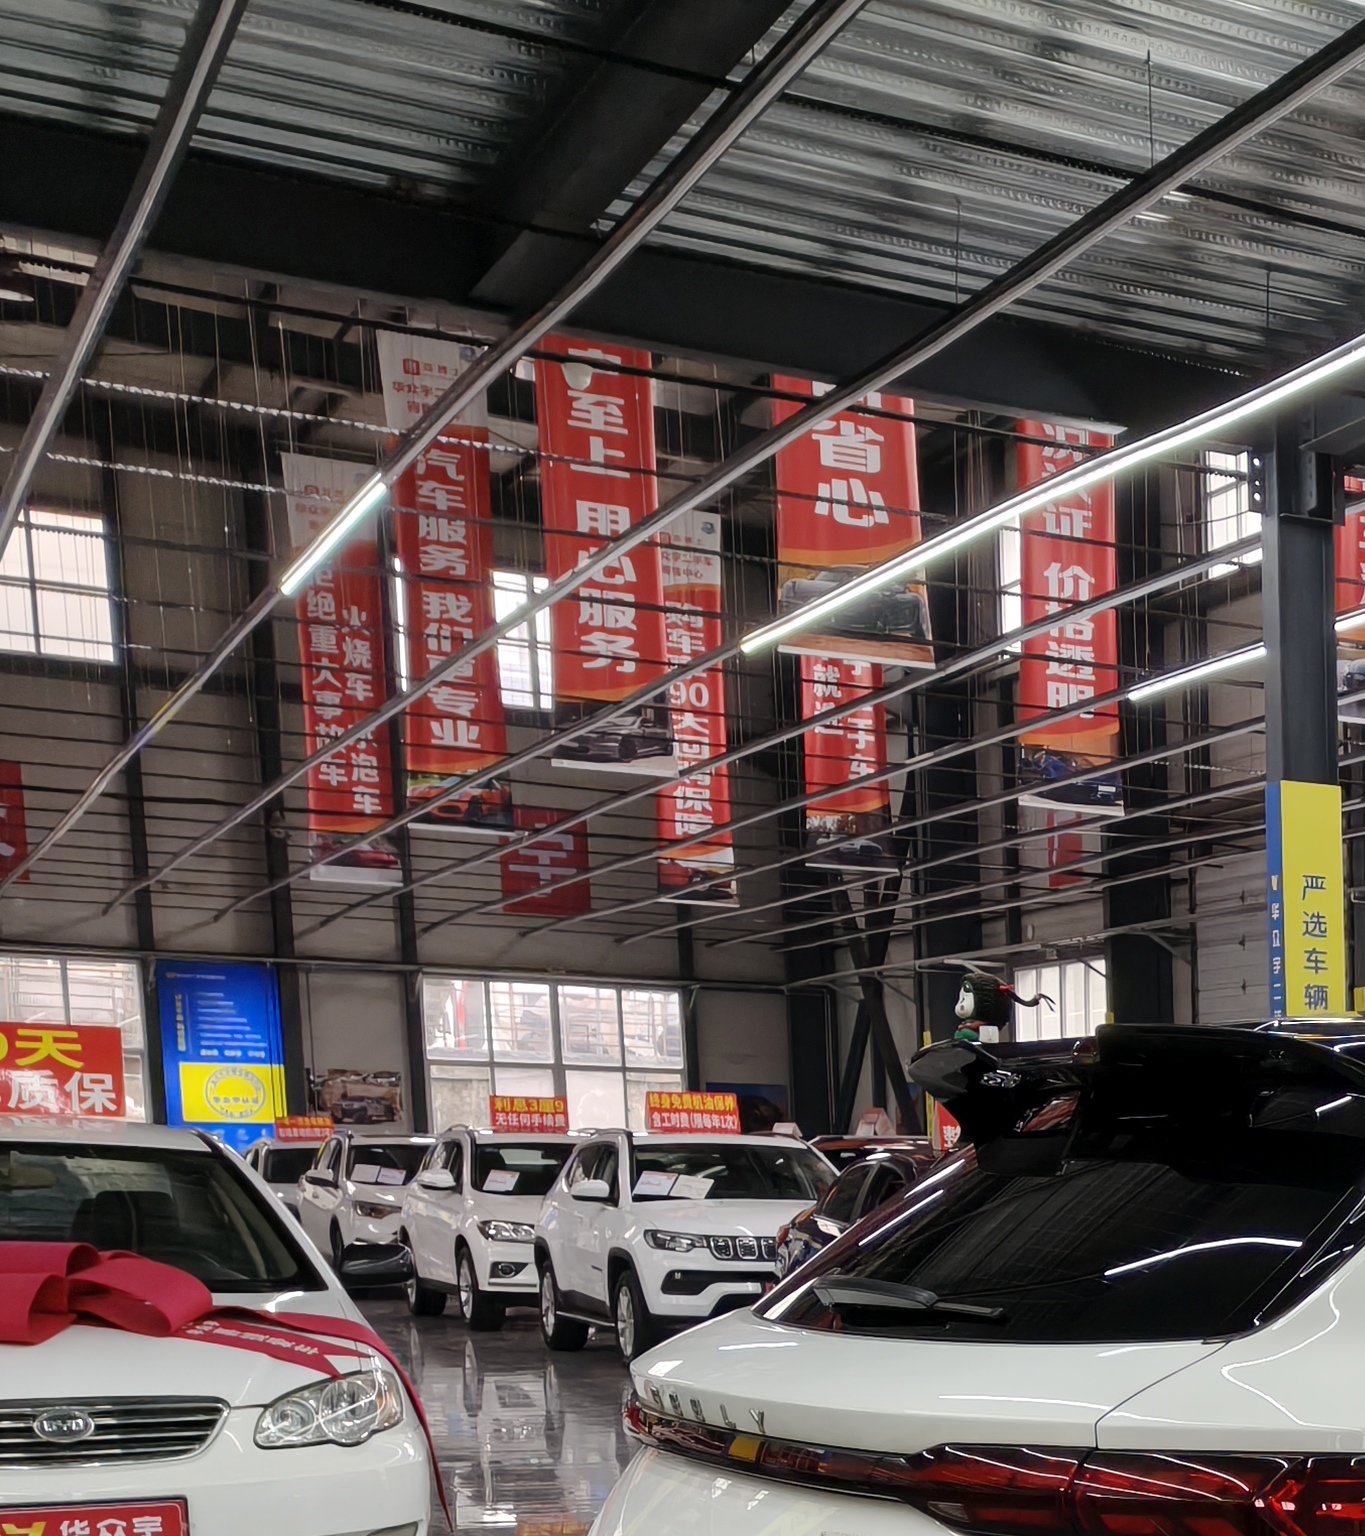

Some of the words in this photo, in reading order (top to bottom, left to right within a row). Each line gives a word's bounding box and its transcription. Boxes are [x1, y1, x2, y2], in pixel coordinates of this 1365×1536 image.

[417, 447, 469, 577] 汽车服务
[812, 381, 890, 528] 省心
[342, 605, 374, 702] 火烧车
[1302, 874, 1329, 1011] 严选车辆
